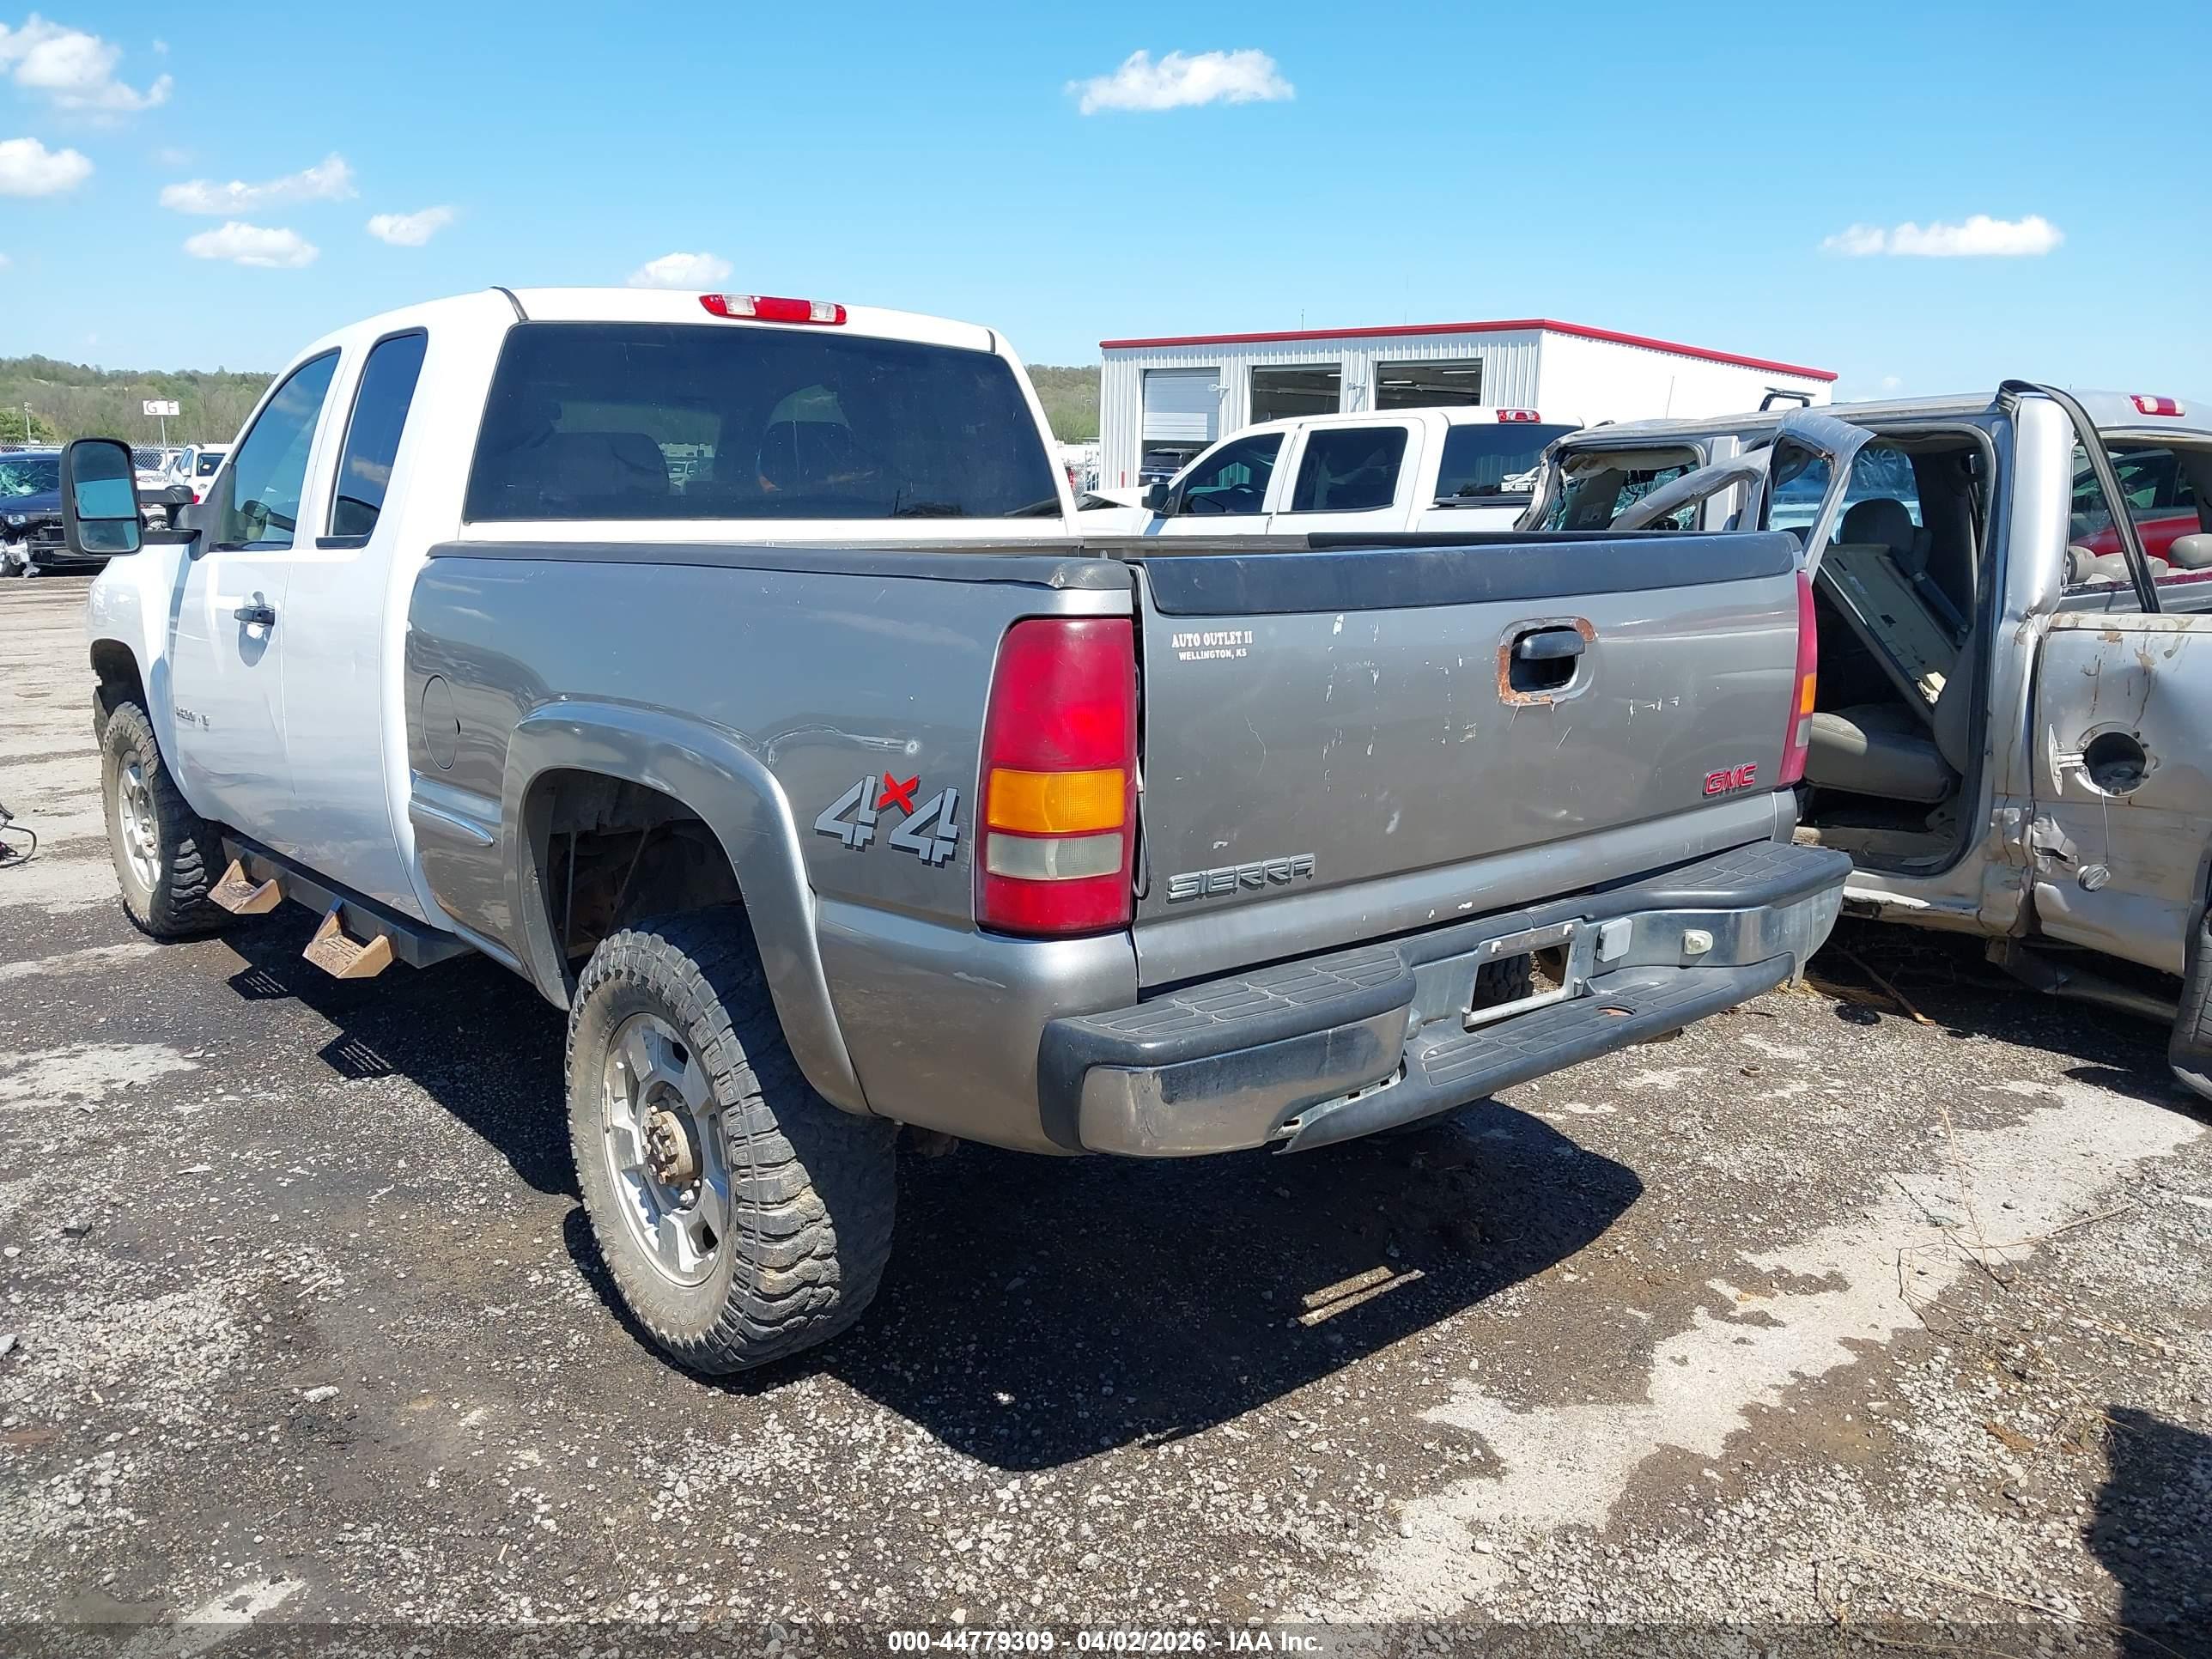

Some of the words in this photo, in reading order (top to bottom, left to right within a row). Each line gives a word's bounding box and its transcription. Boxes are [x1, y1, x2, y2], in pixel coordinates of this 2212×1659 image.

[147, 401, 157, 414] G
[167, 401, 176, 414] F
[1171, 633, 1201, 648] AUTO
[1203, 631, 1243, 647] OUTLET
[1243, 630, 1253, 644] II
[1178, 649, 1235, 660] WELLINGTON,
[1236, 647, 1248, 657] KS
[1705, 763, 1758, 794] GMC
[1167, 853, 1316, 901] SIERRA
